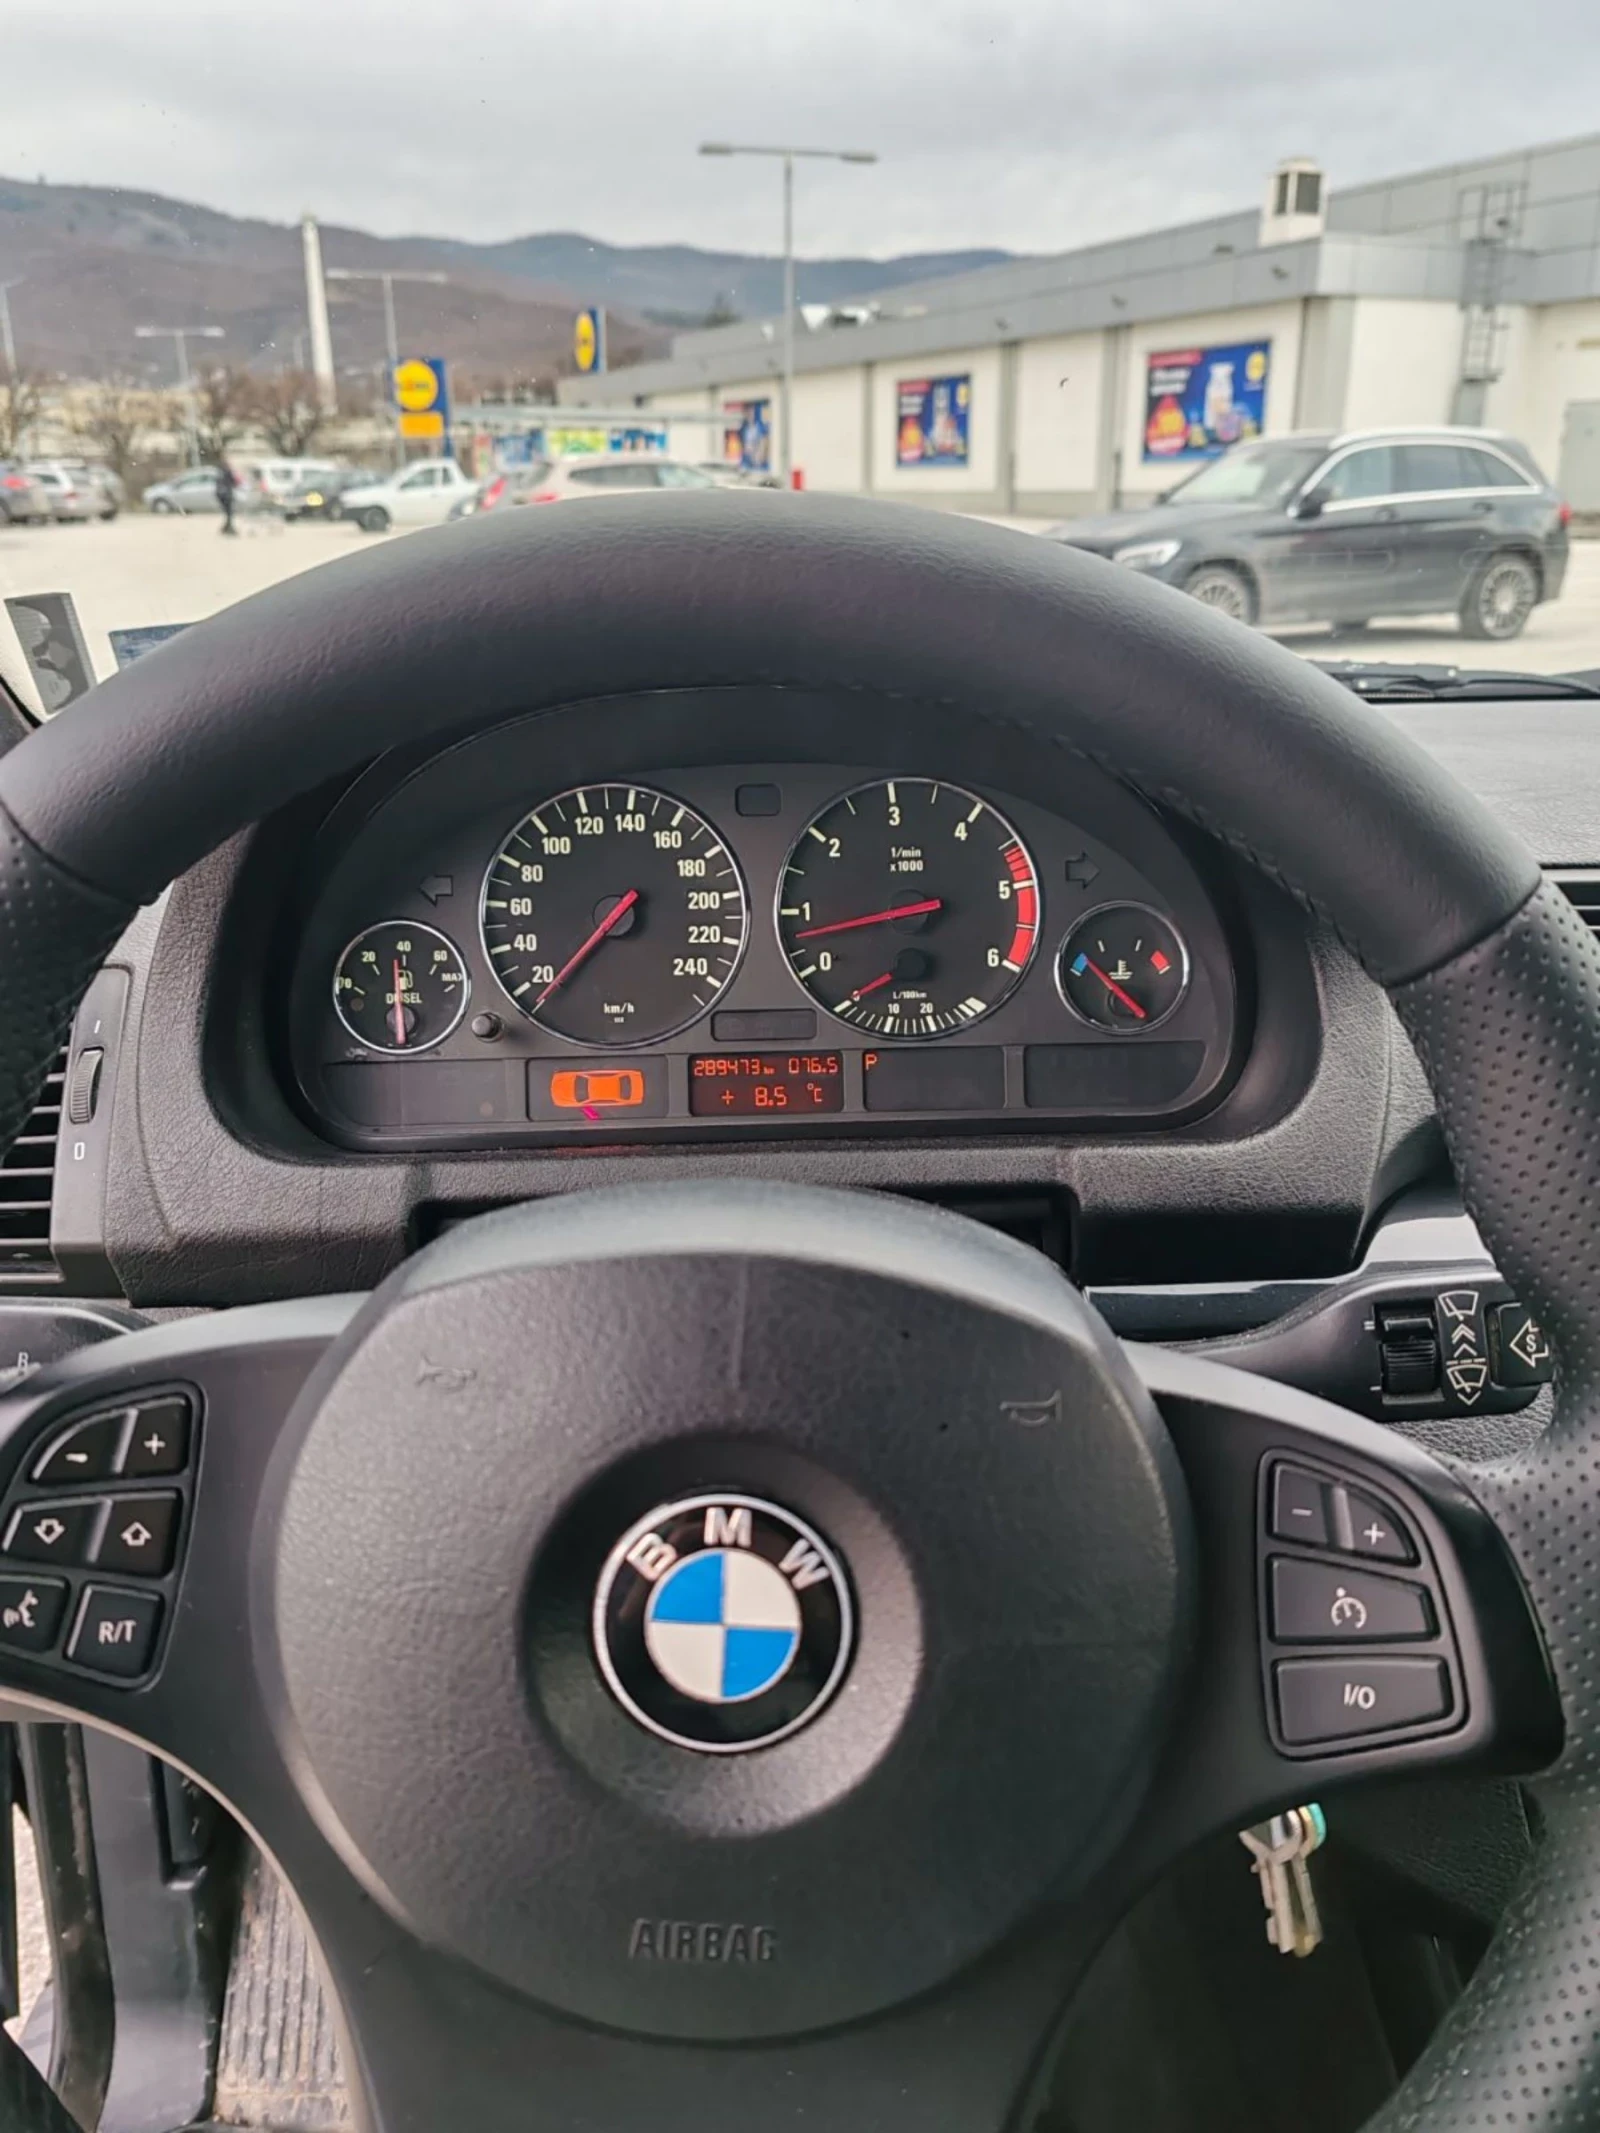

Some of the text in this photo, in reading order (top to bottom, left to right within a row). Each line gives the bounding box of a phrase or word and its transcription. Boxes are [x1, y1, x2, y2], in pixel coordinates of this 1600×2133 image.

[574, 816, 604, 835] 120
[615, 813, 646, 832] 140
[888, 806, 901, 826] 3
[653, 830, 682, 849] 160
[954, 821, 968, 841] 4
[541, 836, 571, 855] 100
[828, 838, 841, 857] 2
[890, 847, 922, 858] 1/min
[521, 864, 543, 882] 80
[677, 859, 706, 877] 180
[998, 880, 1010, 900] 5
[510, 897, 532, 916] 60
[688, 891, 720, 909] 200
[802, 902, 811, 921] 1
[513, 933, 537, 952] 40
[688, 926, 720, 944] 220
[396, 940, 411, 952] 40
[361, 951, 376, 963] 20
[433, 950, 448, 962] 60
[819, 952, 831, 971] 0
[987, 948, 999, 967] 6
[532, 965, 554, 983] 20
[673, 958, 708, 976] 240
[385, 992, 423, 1004] DISEL
[603, 1002, 635, 1014] km/h
[888, 1003, 900, 1014] 10
[920, 1003, 933, 1014] 20
[693, 1058, 760, 1076] 289473
[865, 1053, 878, 1071] P
[755, 1086, 788, 1107] 8.5
[1525, 1334, 1537, 1353] S
[626, 1506, 831, 1591] BMW
[98, 1619, 137, 1644] R/T
[627, 1917, 778, 1964] AIRBAG
